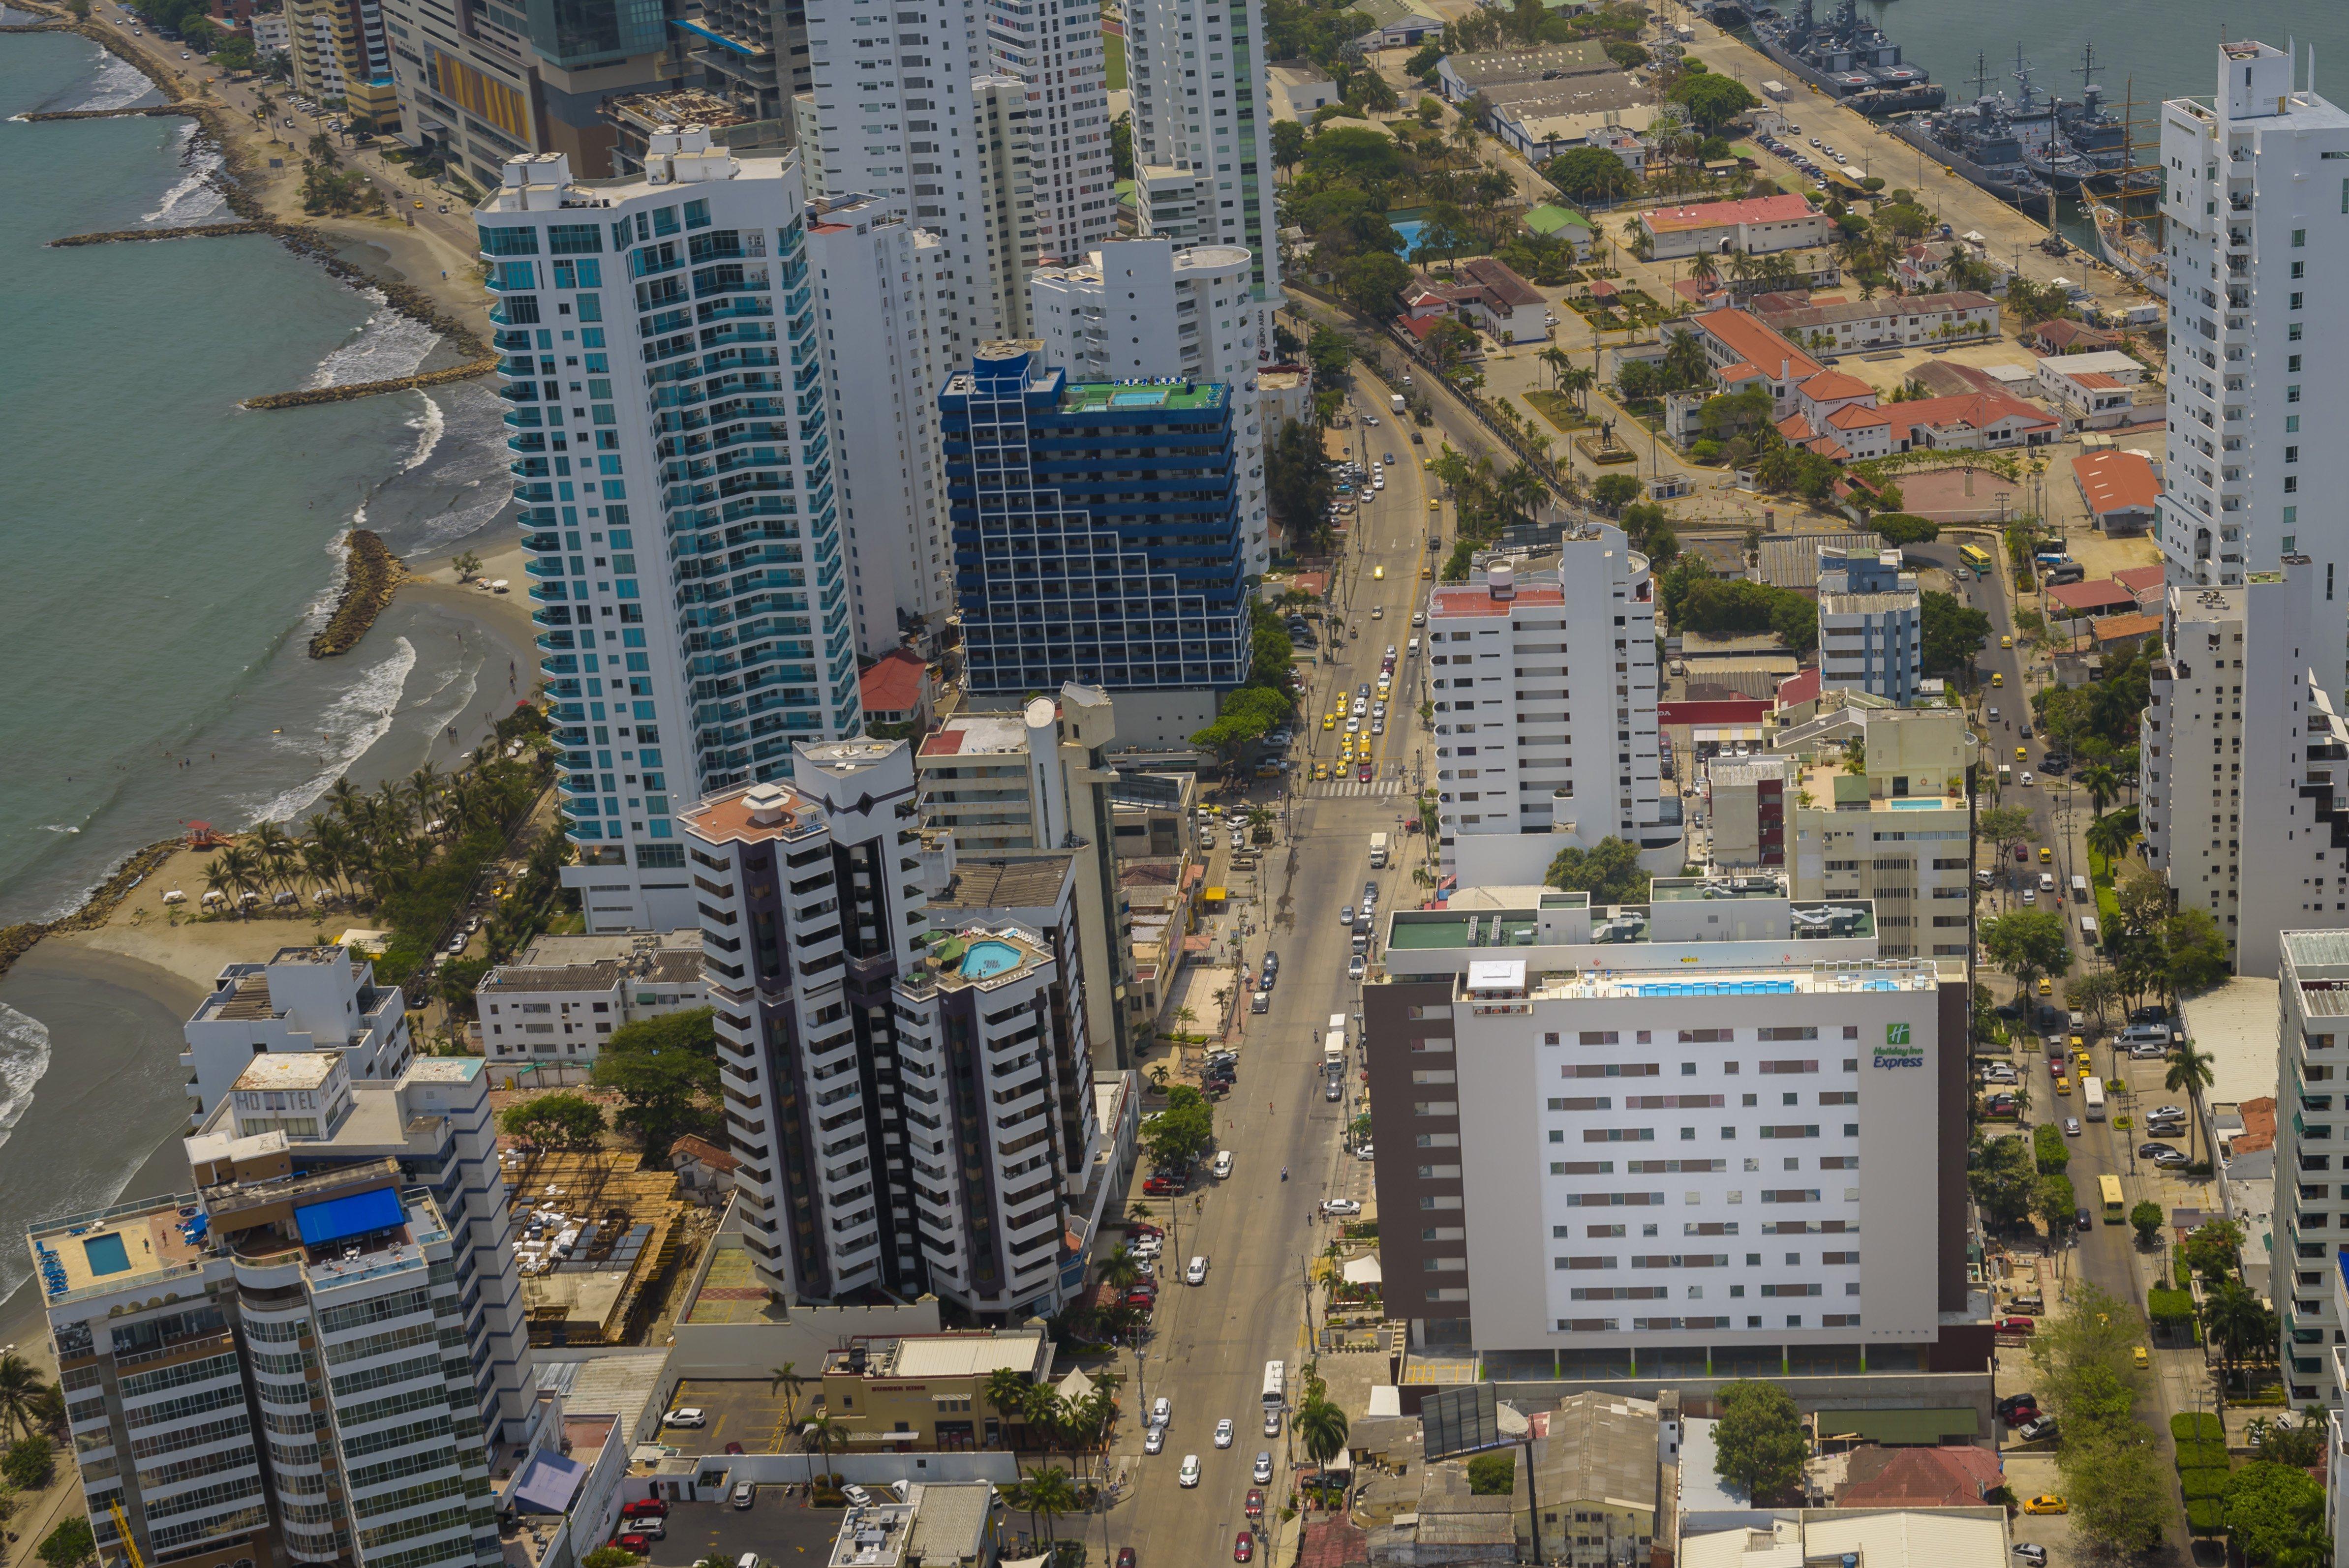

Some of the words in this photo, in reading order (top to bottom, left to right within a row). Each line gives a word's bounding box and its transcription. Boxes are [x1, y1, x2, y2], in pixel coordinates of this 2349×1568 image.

[1873, 1047, 1908, 1056] Holiday
[1909, 1046, 1923, 1055] Inn
[1874, 1056, 1923, 1070] Express
